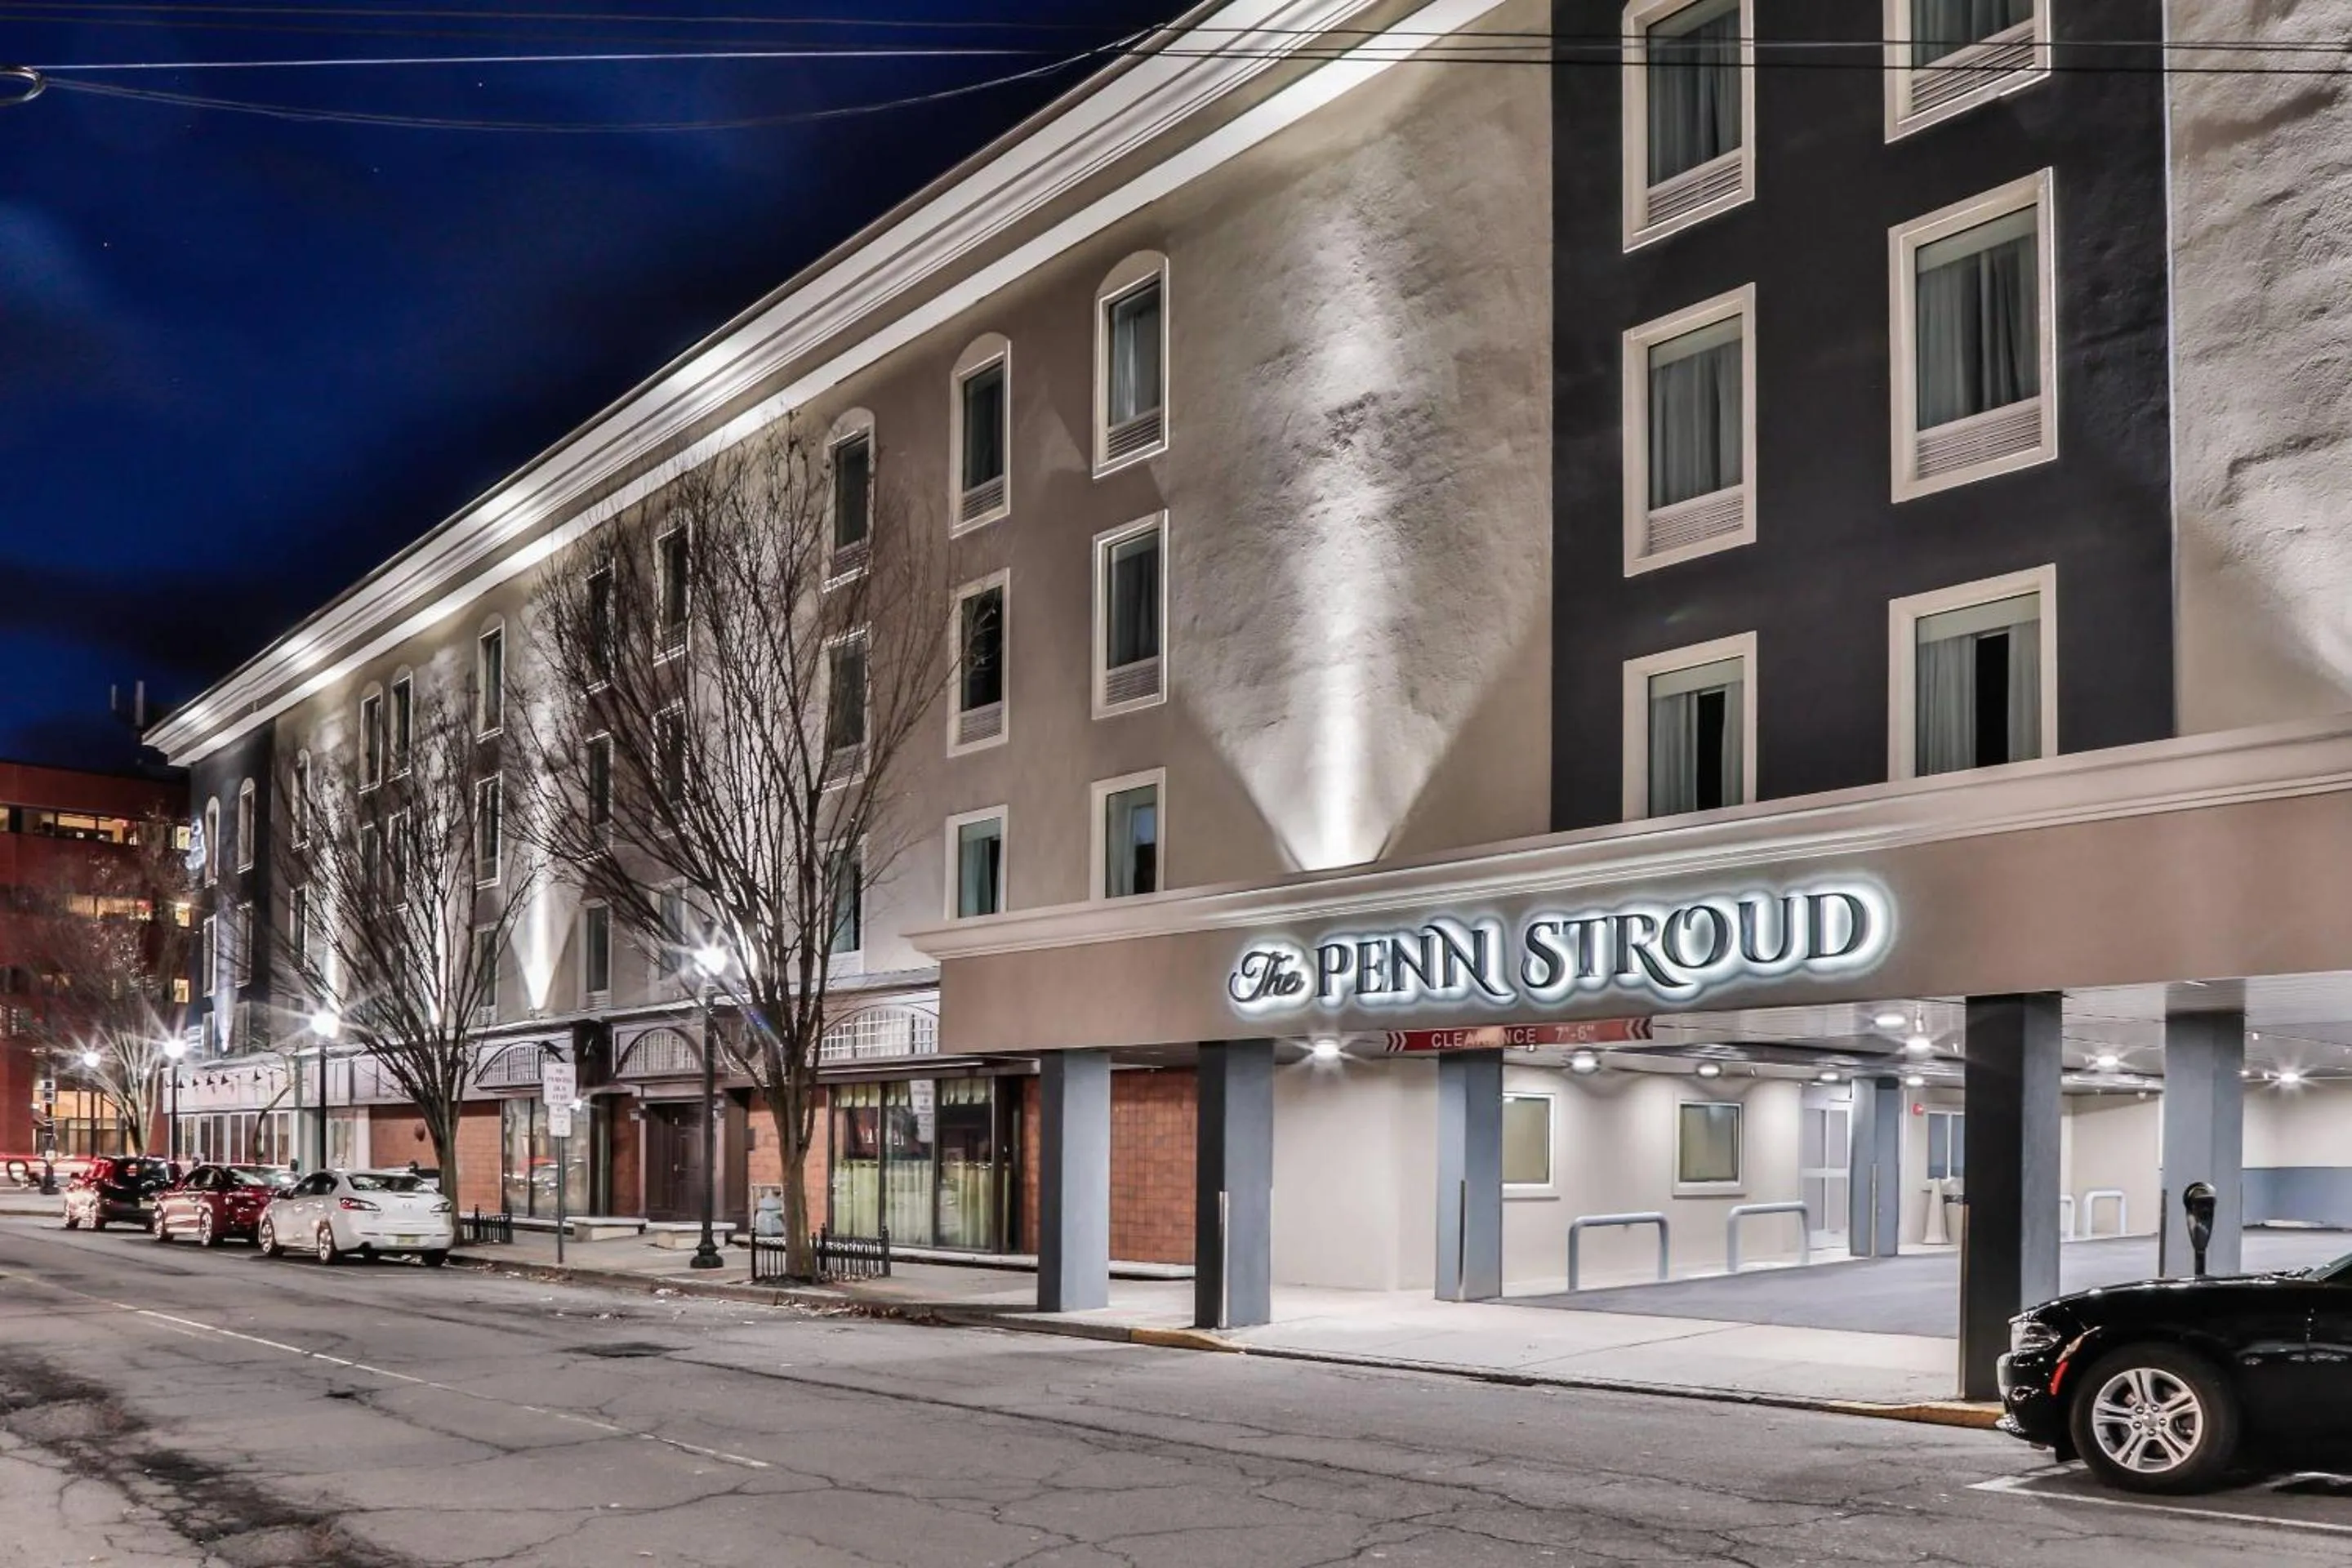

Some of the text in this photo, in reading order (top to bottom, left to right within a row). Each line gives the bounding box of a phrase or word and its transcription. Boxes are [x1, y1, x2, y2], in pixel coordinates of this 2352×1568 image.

[1228, 893, 1866, 1003] The PENN STROUD
[1431, 1027, 1536, 1048] CLEANCE
